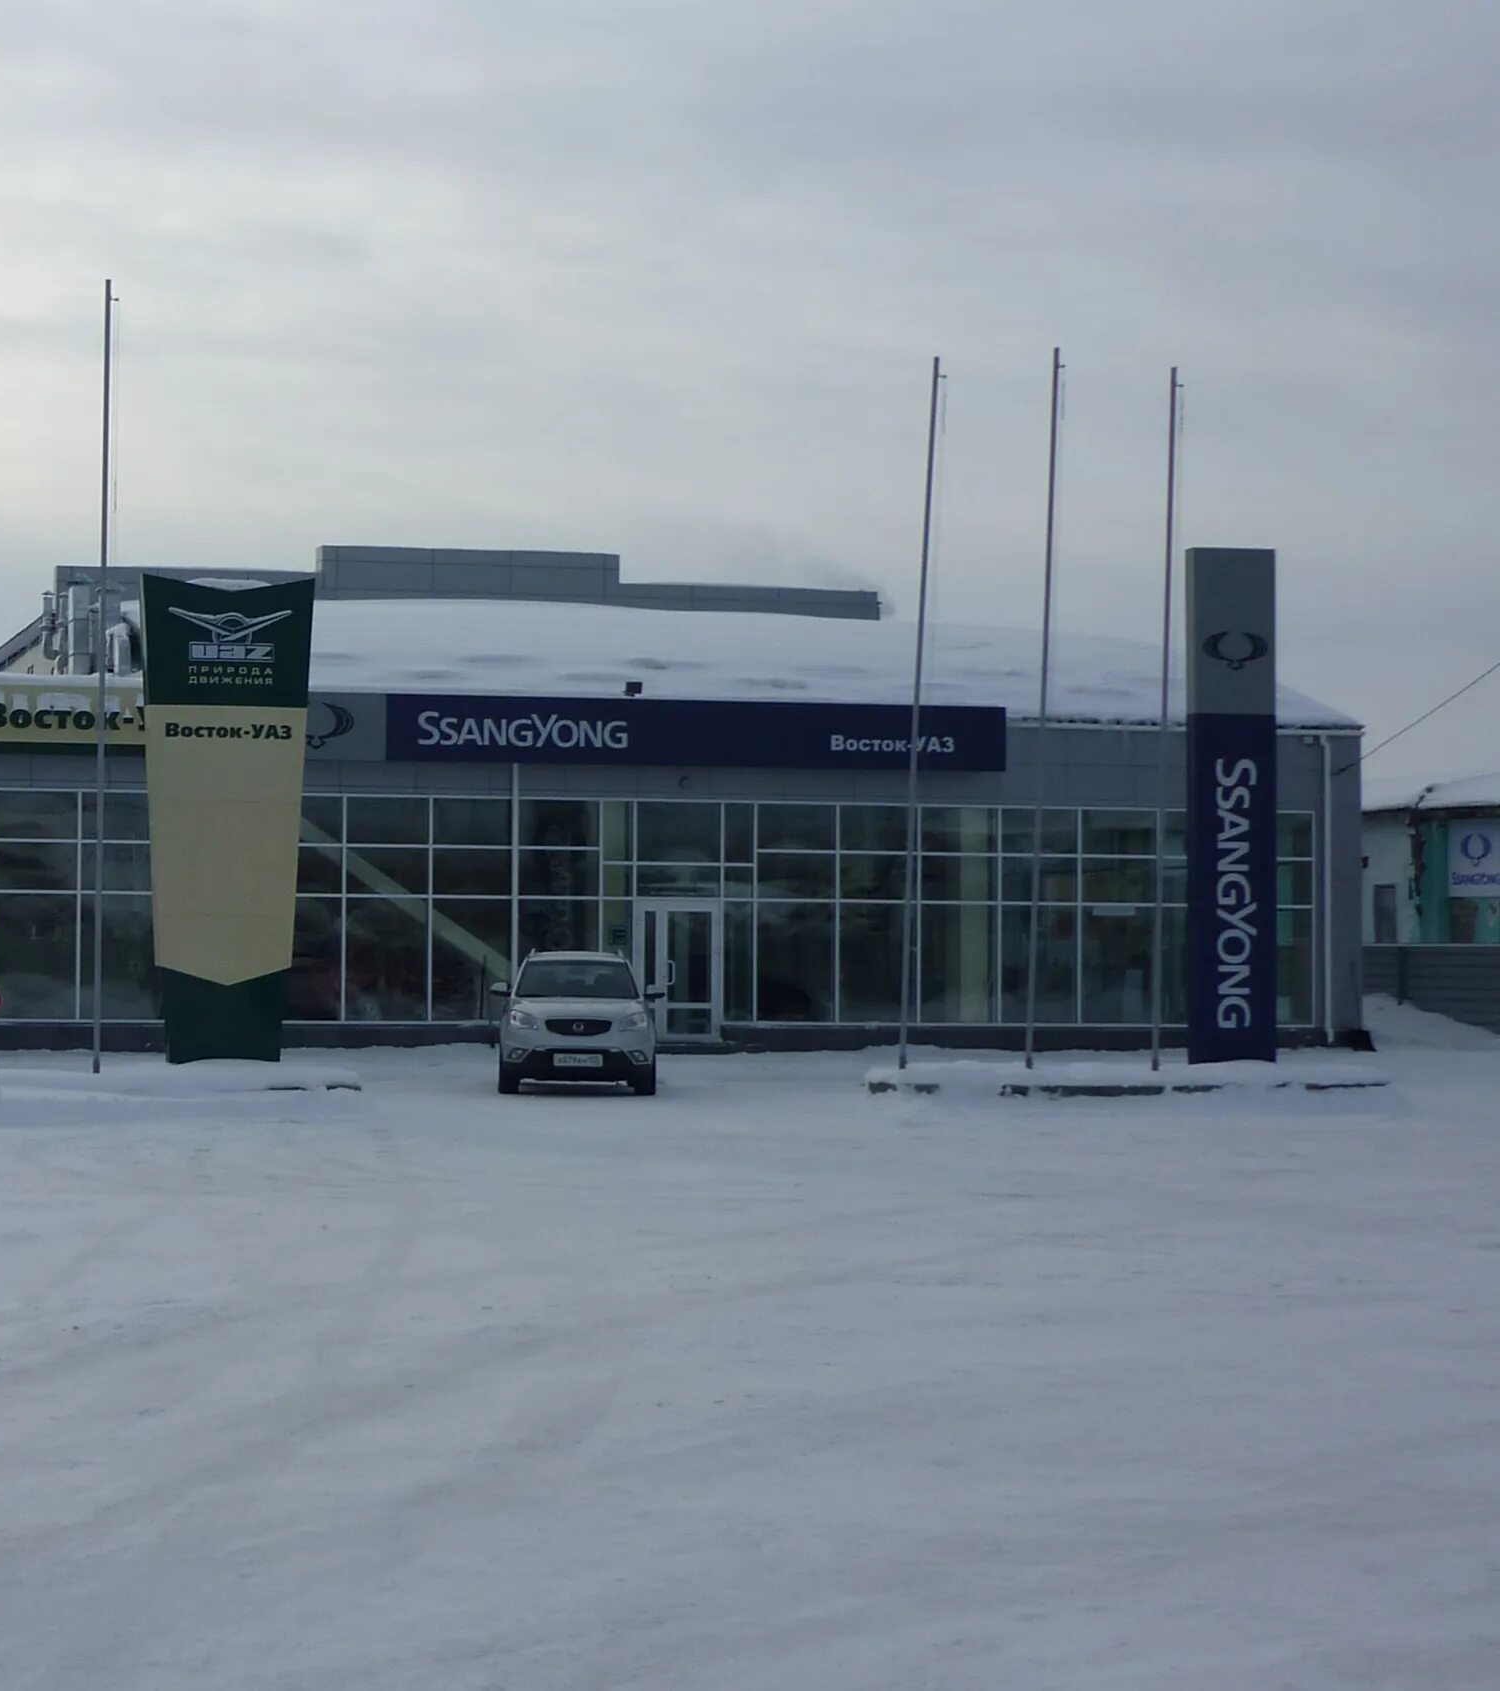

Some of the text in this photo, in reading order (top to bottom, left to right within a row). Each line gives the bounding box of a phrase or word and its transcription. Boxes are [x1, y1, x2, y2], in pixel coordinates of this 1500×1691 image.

[189, 665, 273, 675] ПРИРОДА
[188, 676, 273, 685] ДВИЖЕНИЯ
[164, 722, 293, 740] Восток-УАЗ
[830, 734, 955, 753] Восток-УАЗ
